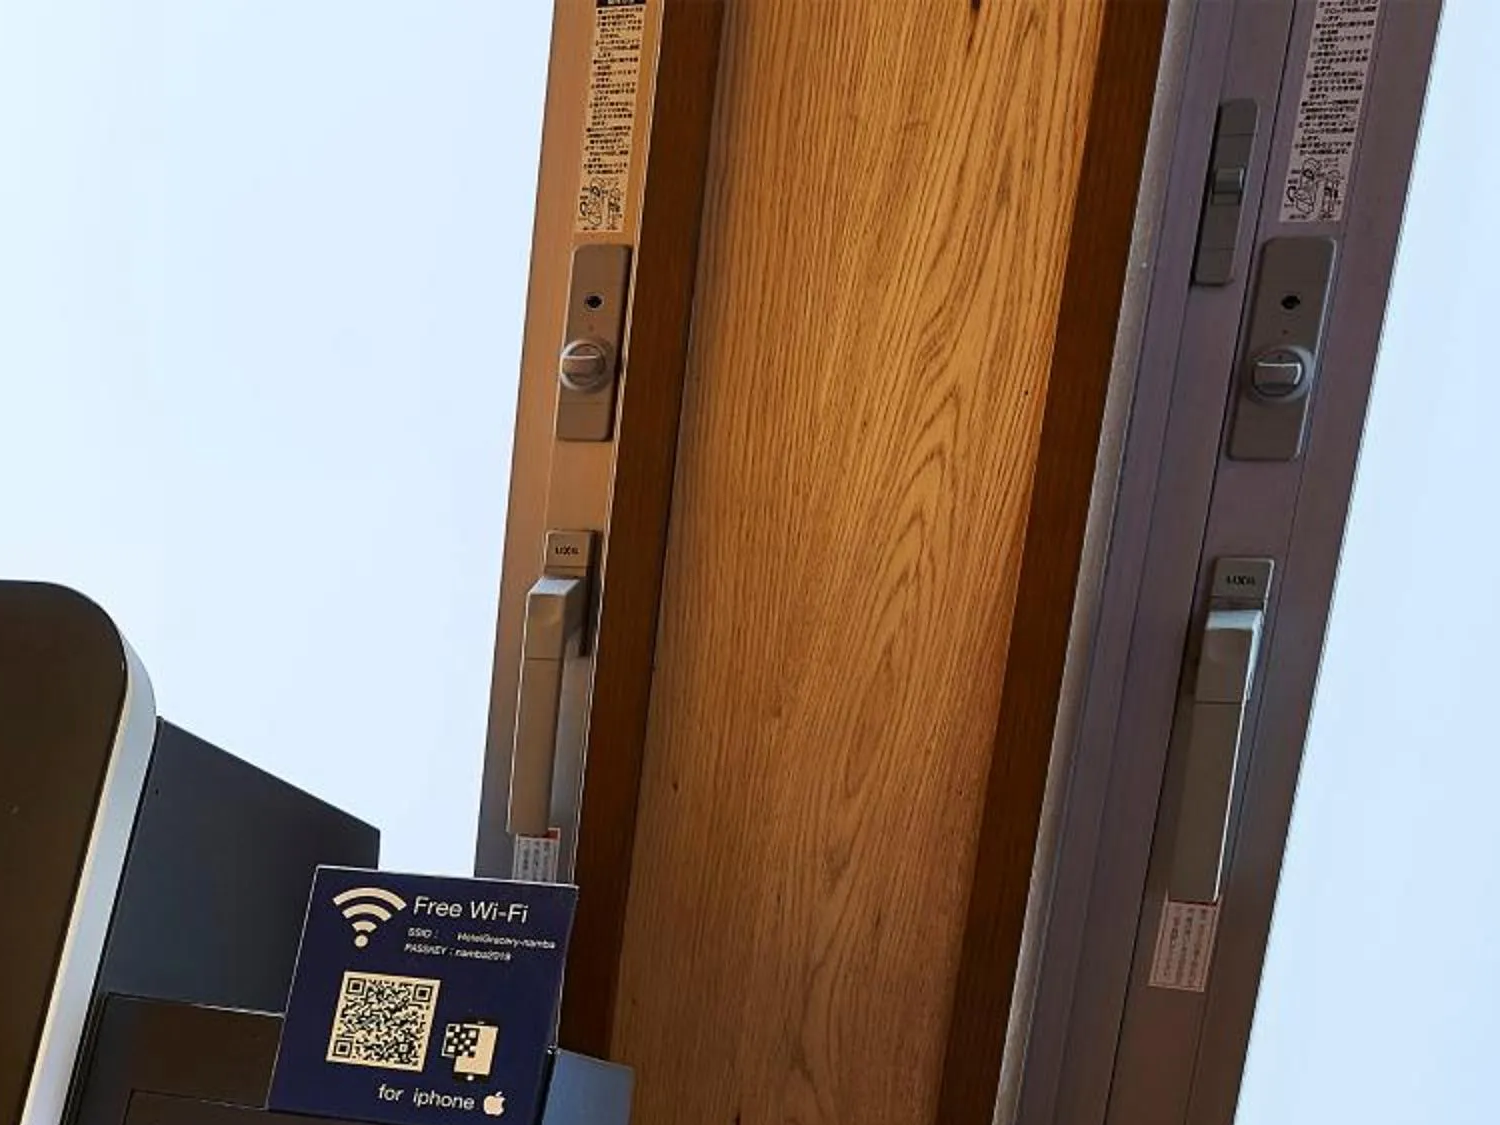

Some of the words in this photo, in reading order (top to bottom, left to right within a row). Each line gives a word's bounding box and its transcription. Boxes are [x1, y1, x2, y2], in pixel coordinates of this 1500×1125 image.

[412, 895, 463, 919] Free
[470, 900, 529, 924] Wi-Fi
[378, 1084, 404, 1101] for
[413, 1088, 475, 1110] iphone
